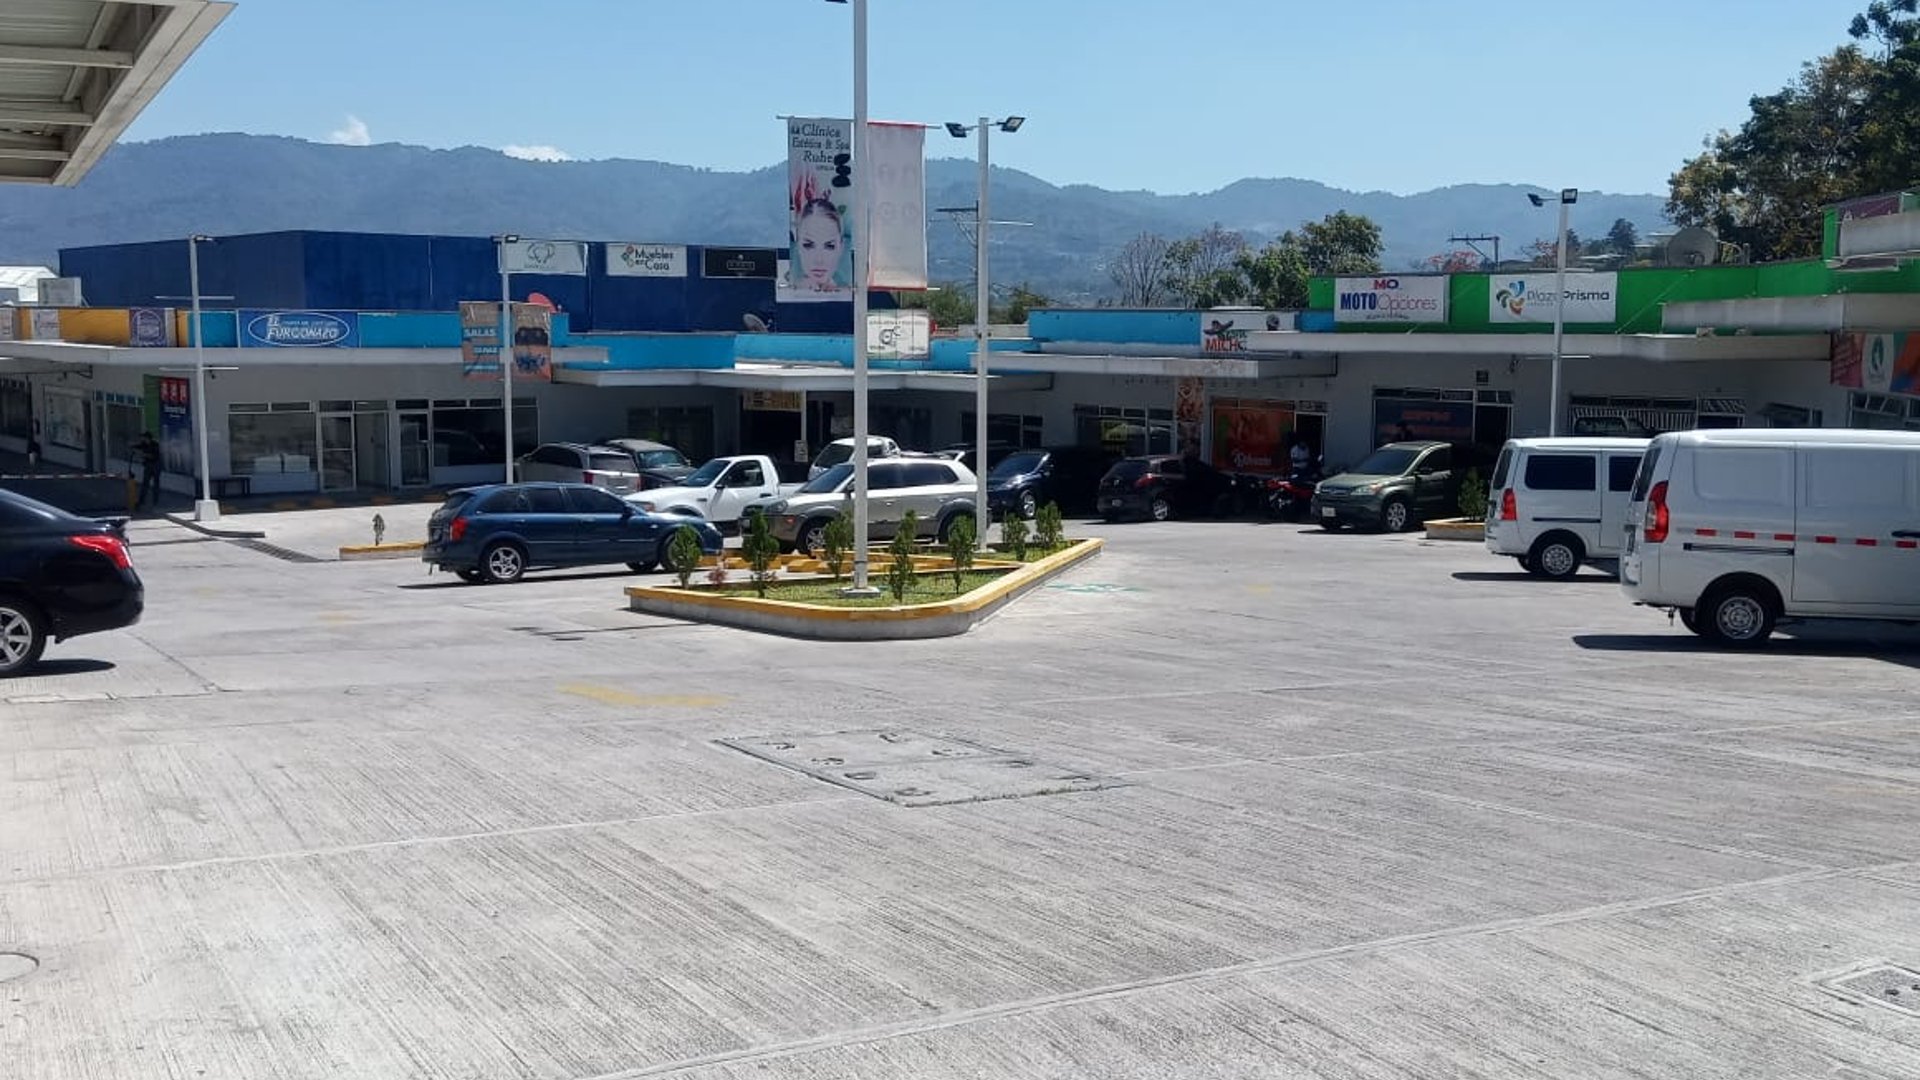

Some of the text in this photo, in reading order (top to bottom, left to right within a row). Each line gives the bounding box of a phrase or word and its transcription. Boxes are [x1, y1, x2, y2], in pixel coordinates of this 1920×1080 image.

[634, 249, 674, 261] Muebles
[645, 260, 670, 272] Casa
[1373, 279, 1399, 289] MO
[266, 327, 339, 341] FURGONAZO
